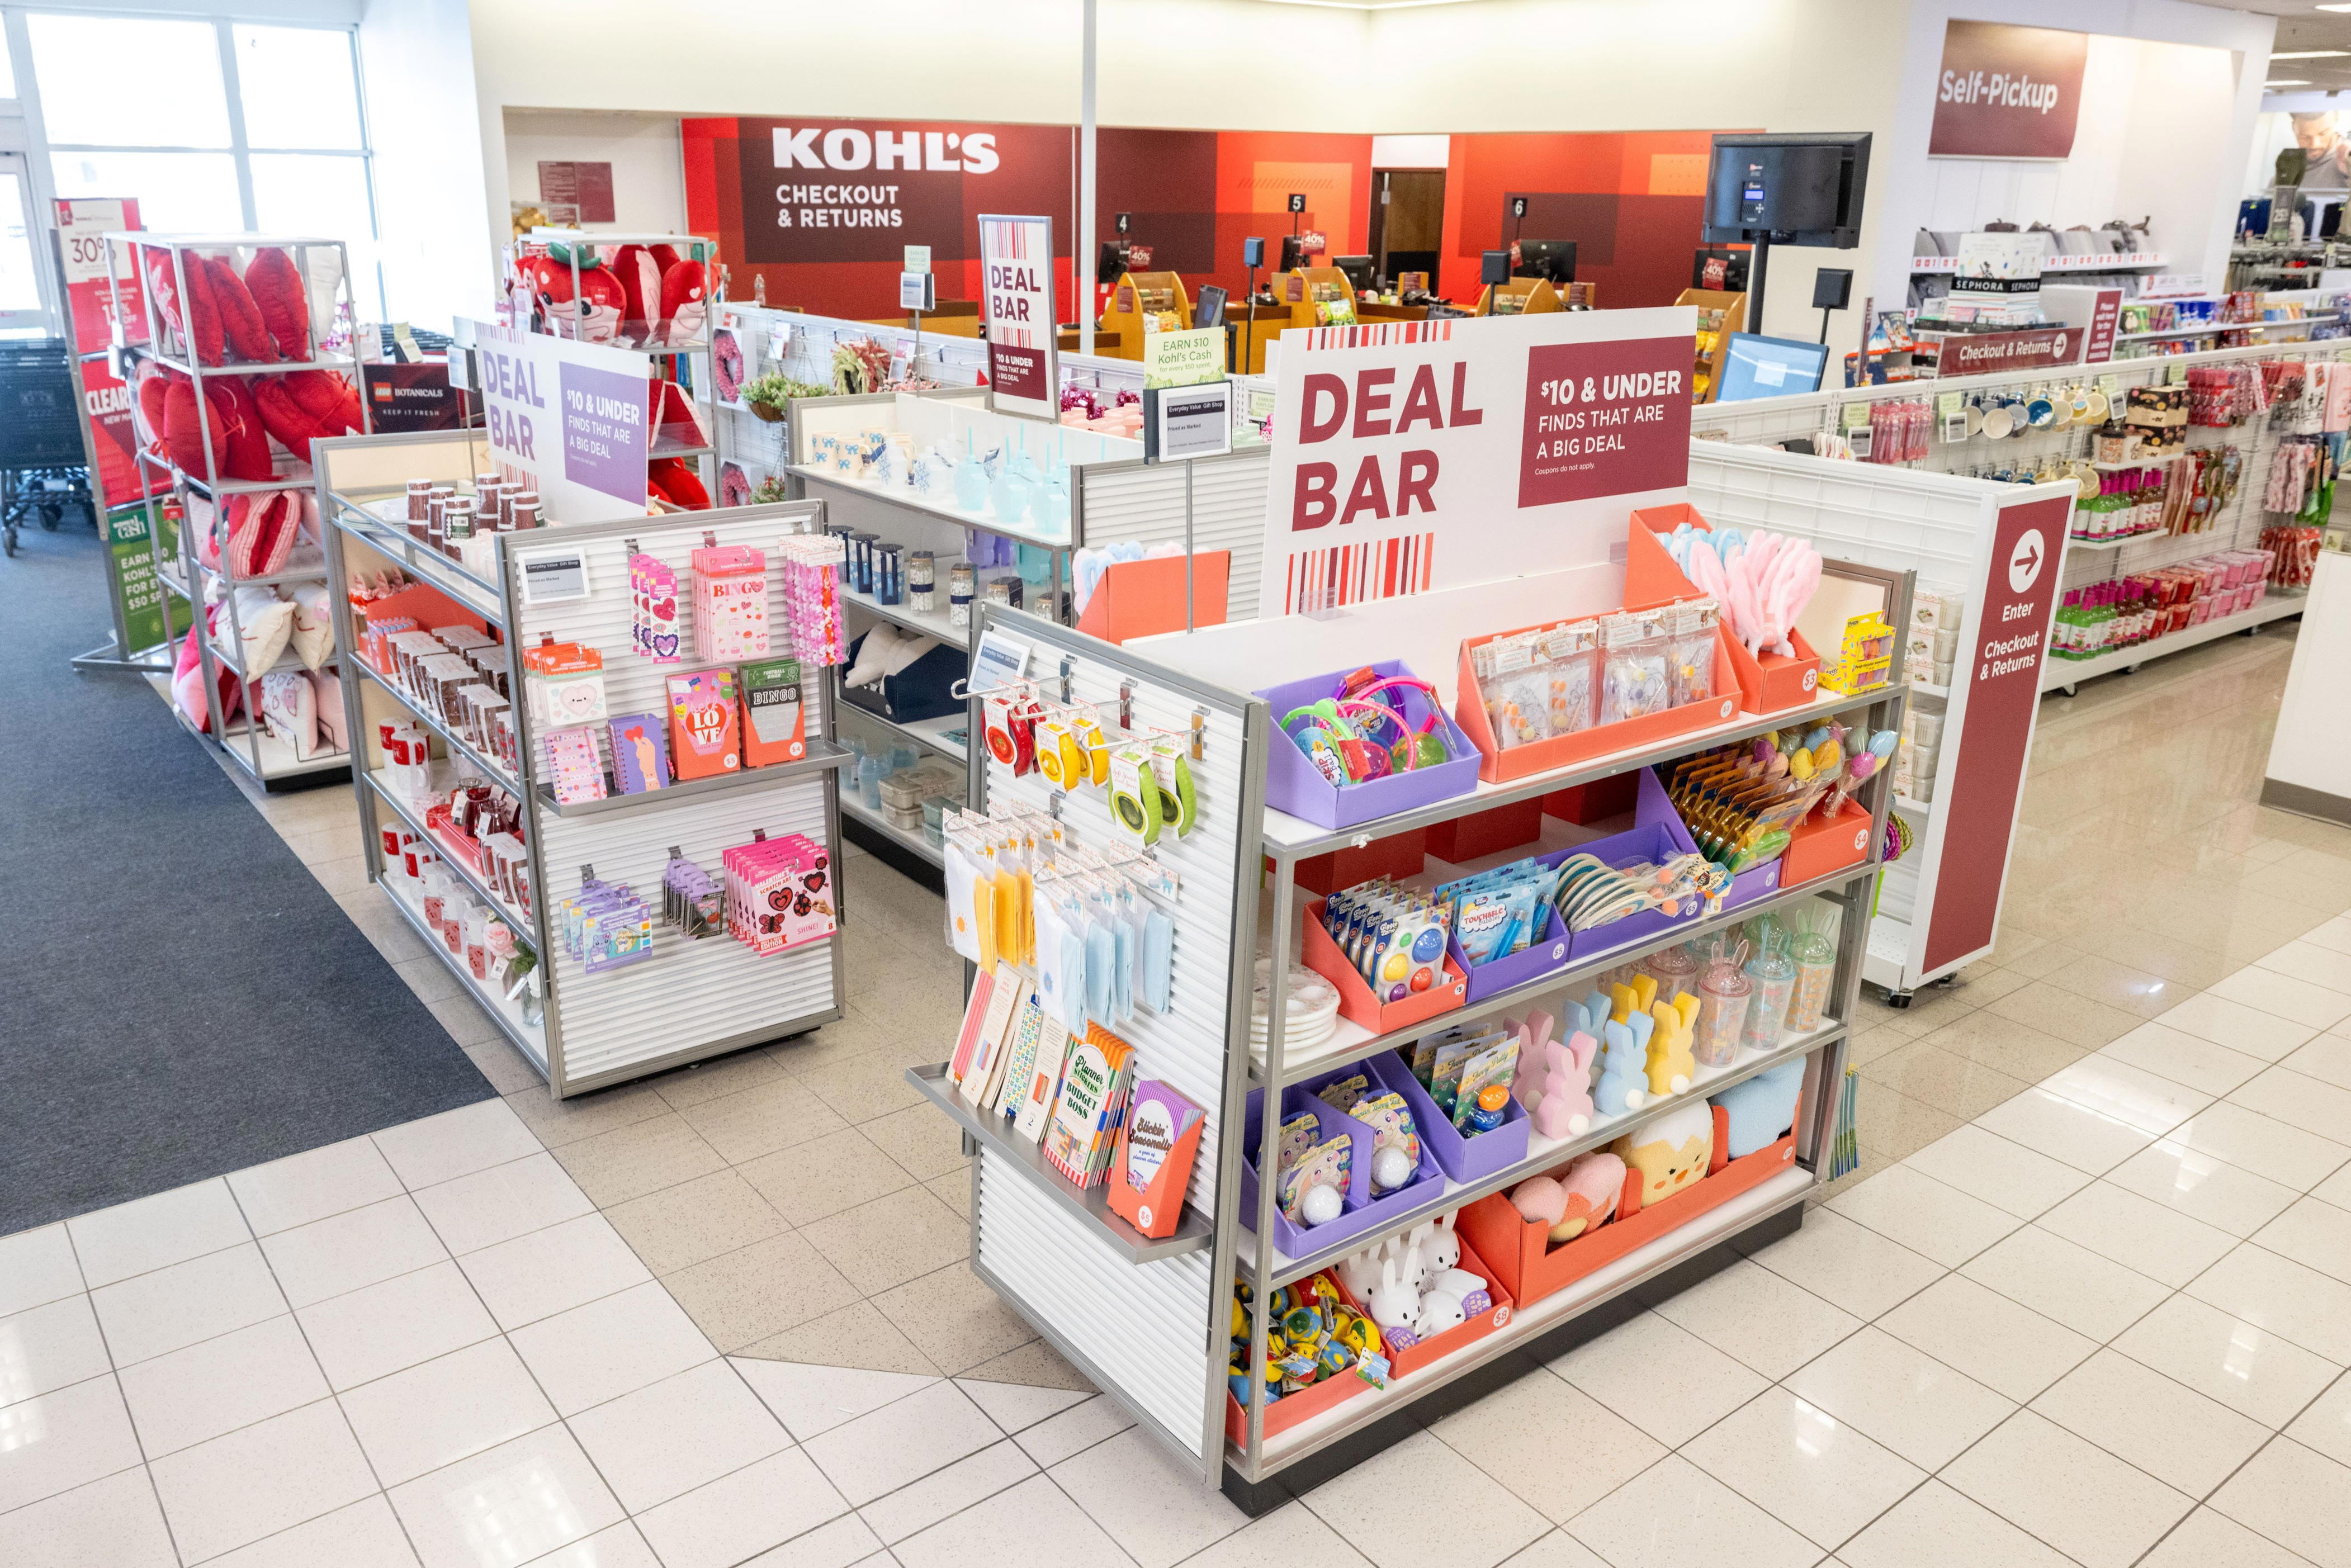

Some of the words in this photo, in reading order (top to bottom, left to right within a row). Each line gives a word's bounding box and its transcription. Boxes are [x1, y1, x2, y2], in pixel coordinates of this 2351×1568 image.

[1940, 68, 2058, 115] Self-Pickup
[772, 127, 1000, 174] KOHL'S
[776, 184, 899, 205] CHECKOUT
[1293, 196, 1301, 210] 5
[1515, 200, 1524, 215] 6
[778, 209, 792, 228] &
[801, 209, 902, 228] RETURNS
[1119, 216, 1127, 230] 4
[1305, 235, 1324, 244] 40%
[1132, 252, 1150, 261] 40%
[991, 265, 1041, 292] DEAL
[1706, 264, 1724, 276] 40%
[1956, 280, 2004, 291] SEPHORA
[2011, 282, 2038, 291] SEPHORA
[993, 295, 1030, 322] BAR
[1163, 339, 1191, 351] EARN
[1194, 337, 1209, 347] $10
[1959, 344, 2004, 361] Checkout
[2007, 341, 2013, 353] &
[2016, 340, 2051, 356] Returns
[1005, 354, 1010, 363] &
[1010, 356, 1033, 367] UNDER
[1158, 353, 1186, 364] Kohl's
[1189, 350, 1212, 361] Cash
[1196, 362, 1212, 370] spent.
[483, 350, 545, 409] DEAL
[1541, 378, 1574, 406] $10
[1581, 376, 1596, 402] &
[1603, 370, 1681, 401] UNDER
[395, 388, 443, 398] BOTANICALS
[567, 389, 583, 411] $10
[586, 393, 594, 414] &
[596, 396, 640, 426] UNDER
[1299, 361, 1483, 445] DEAL
[1538, 411, 1586, 433] FINDS
[1590, 408, 1630, 428] THAT
[1634, 404, 1664, 423] ARE
[489, 404, 536, 461] BAR
[568, 415, 590, 432] FINDS
[592, 421, 611, 439] THAT
[614, 428, 631, 444] ARE
[569, 435, 574, 448] A
[576, 438, 589, 452] BIG
[590, 441, 611, 459] DEAL
[1536, 442, 1548, 459] A
[1553, 437, 1580, 456] BIG
[1584, 433, 1626, 454] DEAL
[1535, 467, 1559, 476] Coupons
[1579, 463, 1596, 472] apply.
[1291, 449, 1440, 532] BAR
[121, 552, 150, 569] EARN
[126, 582, 148, 596] FOR
[128, 596, 148, 610] $50
[2002, 602, 2034, 622] Enter
[1984, 630, 2040, 659] Checkout
[1980, 663, 1989, 680] &
[1992, 653, 2036, 678] Returns
[1804, 674, 1815, 687] $3
[690, 695, 718, 715] self
[754, 688, 796, 705] BINGO
[693, 710, 720, 729] LO
[694, 727, 721, 746] VE
[726, 756, 736, 765] $5
[1856, 833, 1868, 850] $4
[755, 869, 791, 889] VALENTINE'S
[760, 880, 782, 895] SCRATCH
[782, 876, 792, 885] ART
[1464, 907, 1504, 925] TOUCHABLE
[1687, 904, 1696, 913] $5
[797, 923, 819, 935] SHINE!
[1380, 921, 1399, 932] Giggle
[1478, 915, 1501, 926] Bubbles
[1381, 927, 1397, 936] Zone
[760, 939, 783, 950] EDITION
[1554, 946, 1563, 957] $5
[1075, 1055, 1104, 1085] Planner
[971, 1082, 976, 1092] 2
[1073, 1067, 1098, 1093] STICKERS
[1066, 1081, 1098, 1111] BUDGET
[1372, 1100, 1389, 1112] Bunny
[1390, 1096, 1401, 1106] Tail
[1067, 1097, 1089, 1120] BOSS
[1028, 1117, 1034, 1126] 2
[1137, 1117, 1169, 1138] Stickin'
[1303, 1117, 1314, 1126] Tail
[1128, 1128, 1173, 1155] Seasonally
[1337, 1138, 1348, 1147] Tail
[1141, 1211, 1150, 1223] $5
[1495, 1310, 1508, 1324] $8
